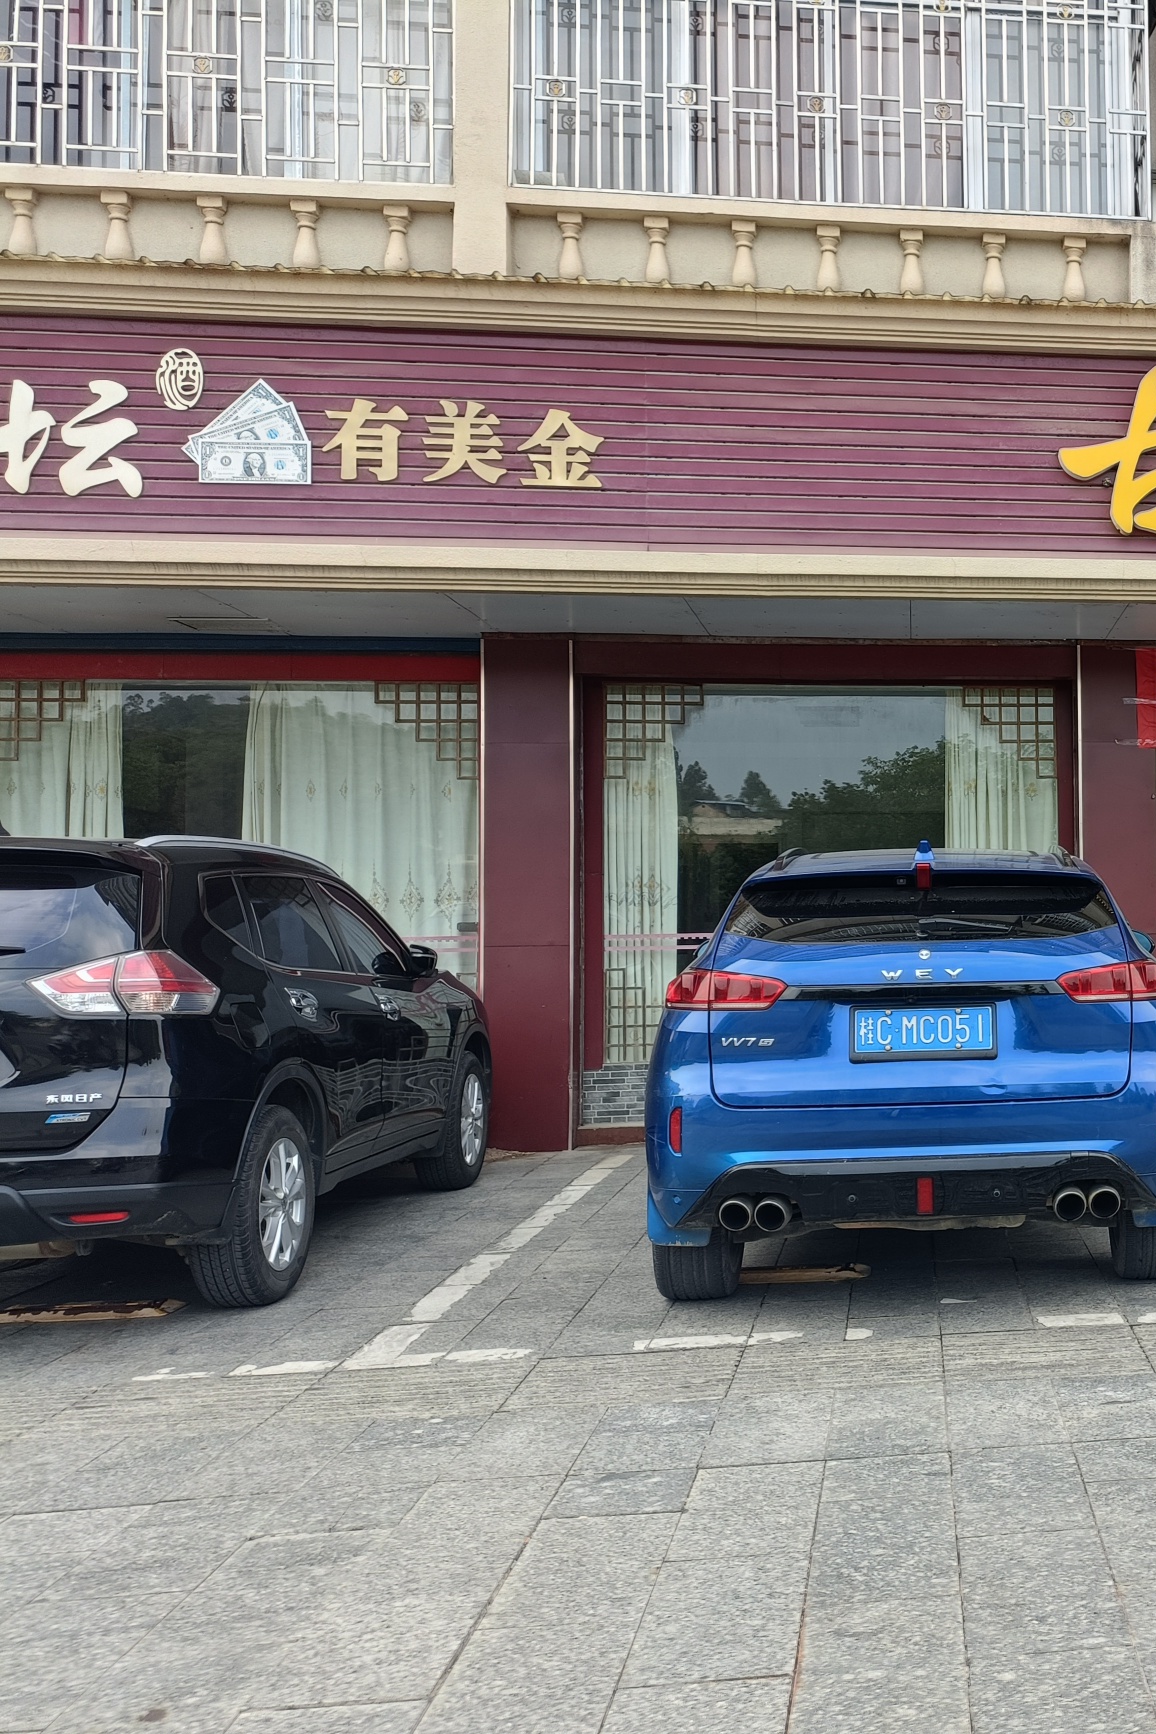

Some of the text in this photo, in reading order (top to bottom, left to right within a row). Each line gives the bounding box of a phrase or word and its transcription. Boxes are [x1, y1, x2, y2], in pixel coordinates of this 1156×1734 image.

[0, 379, 143, 498] 坛
[321, 398, 604, 489] 有美金
[881, 967, 964, 981] WEY
[46, 1093, 103, 1105] 东风日产
